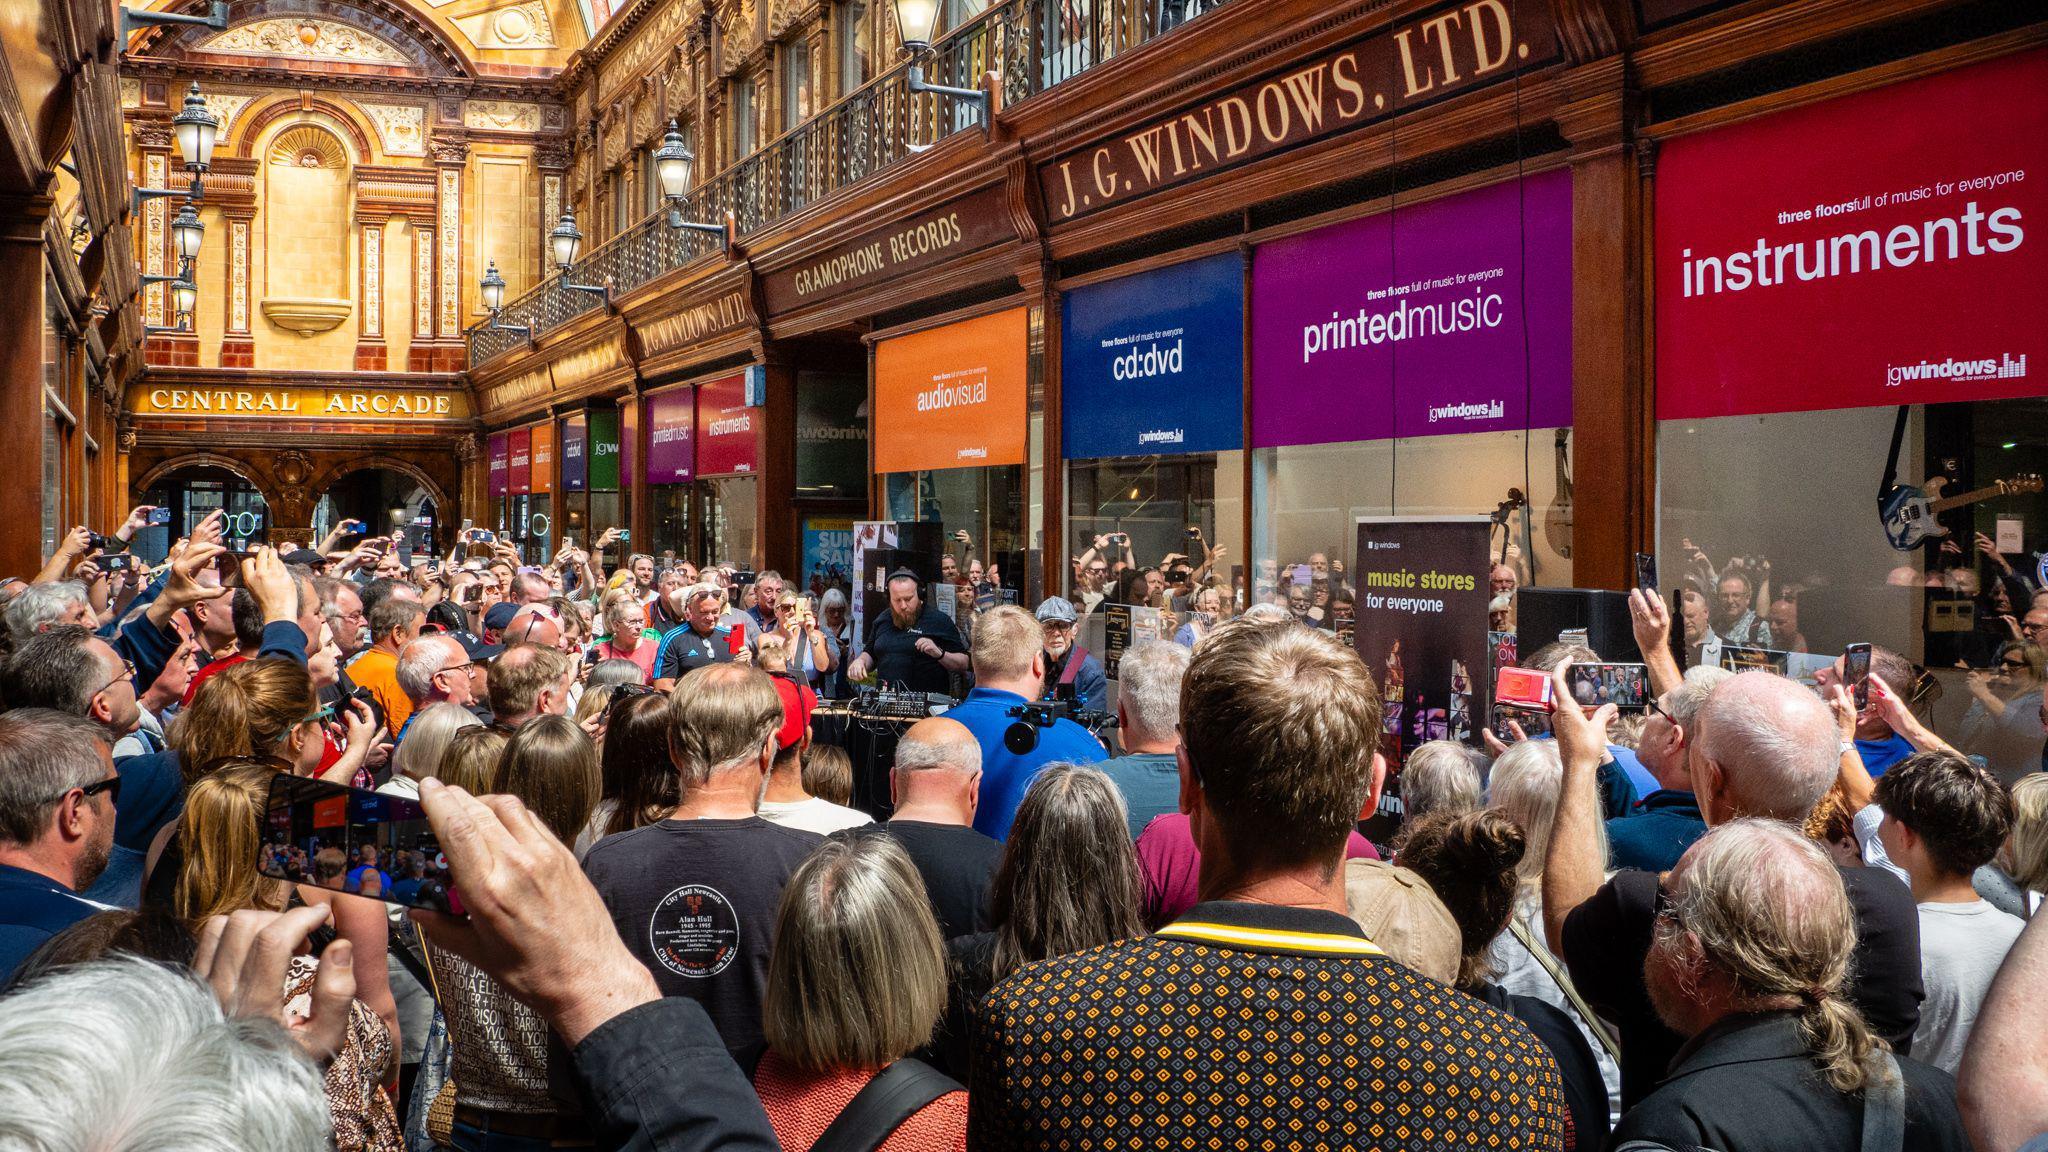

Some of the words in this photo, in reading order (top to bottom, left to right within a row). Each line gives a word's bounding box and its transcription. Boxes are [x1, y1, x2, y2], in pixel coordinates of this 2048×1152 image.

[1393, 0, 1529, 98] LTD.
[1778, 209, 1812, 225] three
[1874, 192, 1888, 208] of
[1891, 185, 1932, 204] music
[1935, 182, 1955, 196] for
[1958, 169, 2025, 192] everyone
[795, 242, 885, 296] GRAMOPHONE
[889, 213, 962, 264] RECORDS
[1683, 201, 2025, 298] instruments
[1367, 290, 1386, 301] three
[1423, 279, 1432, 290] of
[1432, 275, 1455, 289] music
[1456, 273, 1467, 284] for
[1468, 267, 1504, 282] everyone
[1141, 331, 1155, 341] music
[1162, 327, 1184, 338] everyone
[1303, 285, 1503, 364] printedmusic
[1113, 339, 1183, 381] cd:dvd
[1886, 358, 1997, 386] jgwindows
[150, 389, 299, 412] CENTRAL
[325, 393, 451, 415] ARCADE
[917, 375, 987, 412] audiovisual
[709, 412, 751, 437] instruments
[1428, 402, 1489, 422] jgwindows
[653, 423, 689, 448] printedmusic
[1367, 568, 1416, 588] music
[1420, 570, 1475, 591] stores
[1366, 592, 1385, 609] for
[1386, 596, 1444, 615] everyone
[665, 896, 679, 906] City
[679, 888, 693, 897] Hall
[693, 887, 722, 904] Newcastle
[697, 915, 712, 923] Hull
[433, 955, 469, 976] ELBOW
[657, 947, 670, 962] City
[668, 958, 678, 968] of
[676, 963, 709, 975] Newcastle
[521, 1031, 549, 1046] LYON
